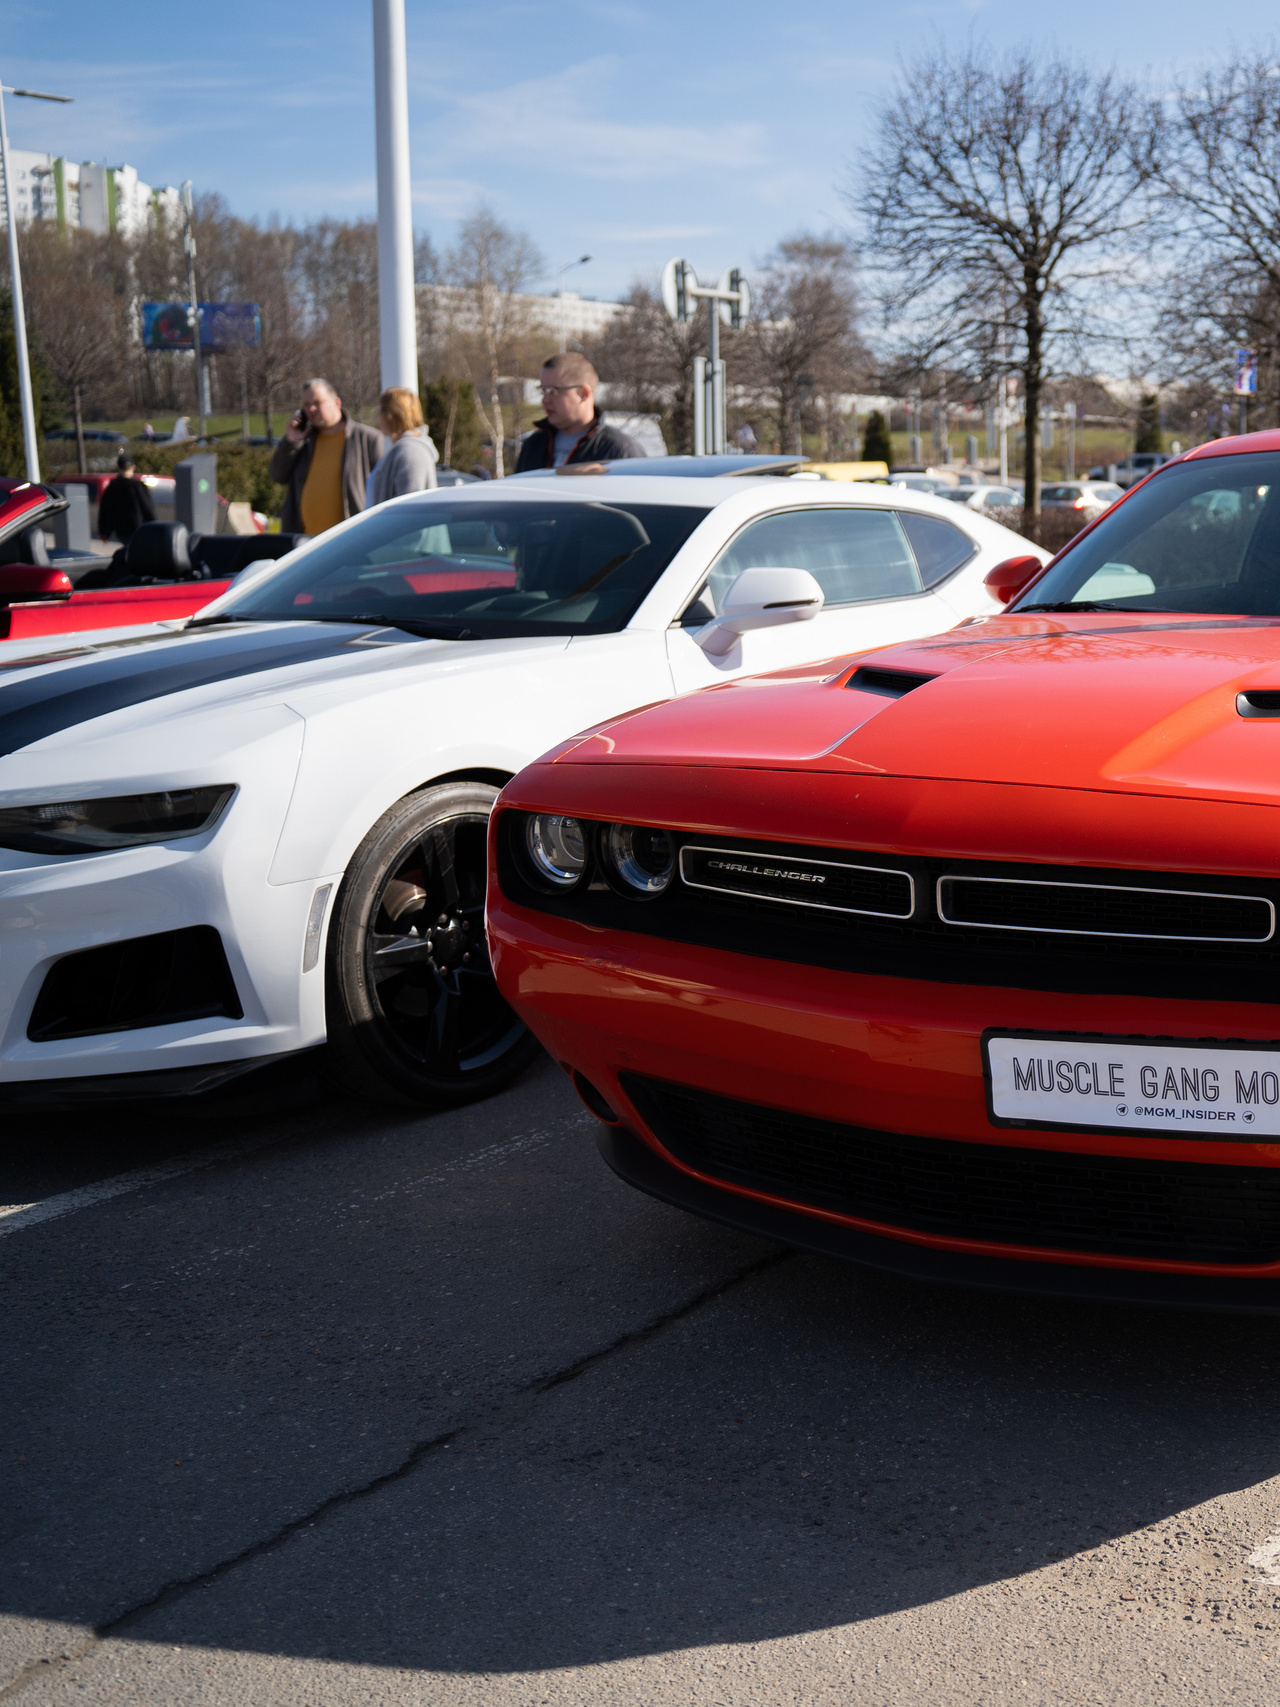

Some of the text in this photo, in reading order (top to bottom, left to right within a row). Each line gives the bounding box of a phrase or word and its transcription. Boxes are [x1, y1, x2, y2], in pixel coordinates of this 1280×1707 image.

[708, 860, 827, 884] CHALLENGER
[1012, 1057, 1126, 1097] MUSCLE
[1140, 1066, 1220, 1102] GANG
[1134, 1106, 1236, 1122] @MGM_INSIDER
